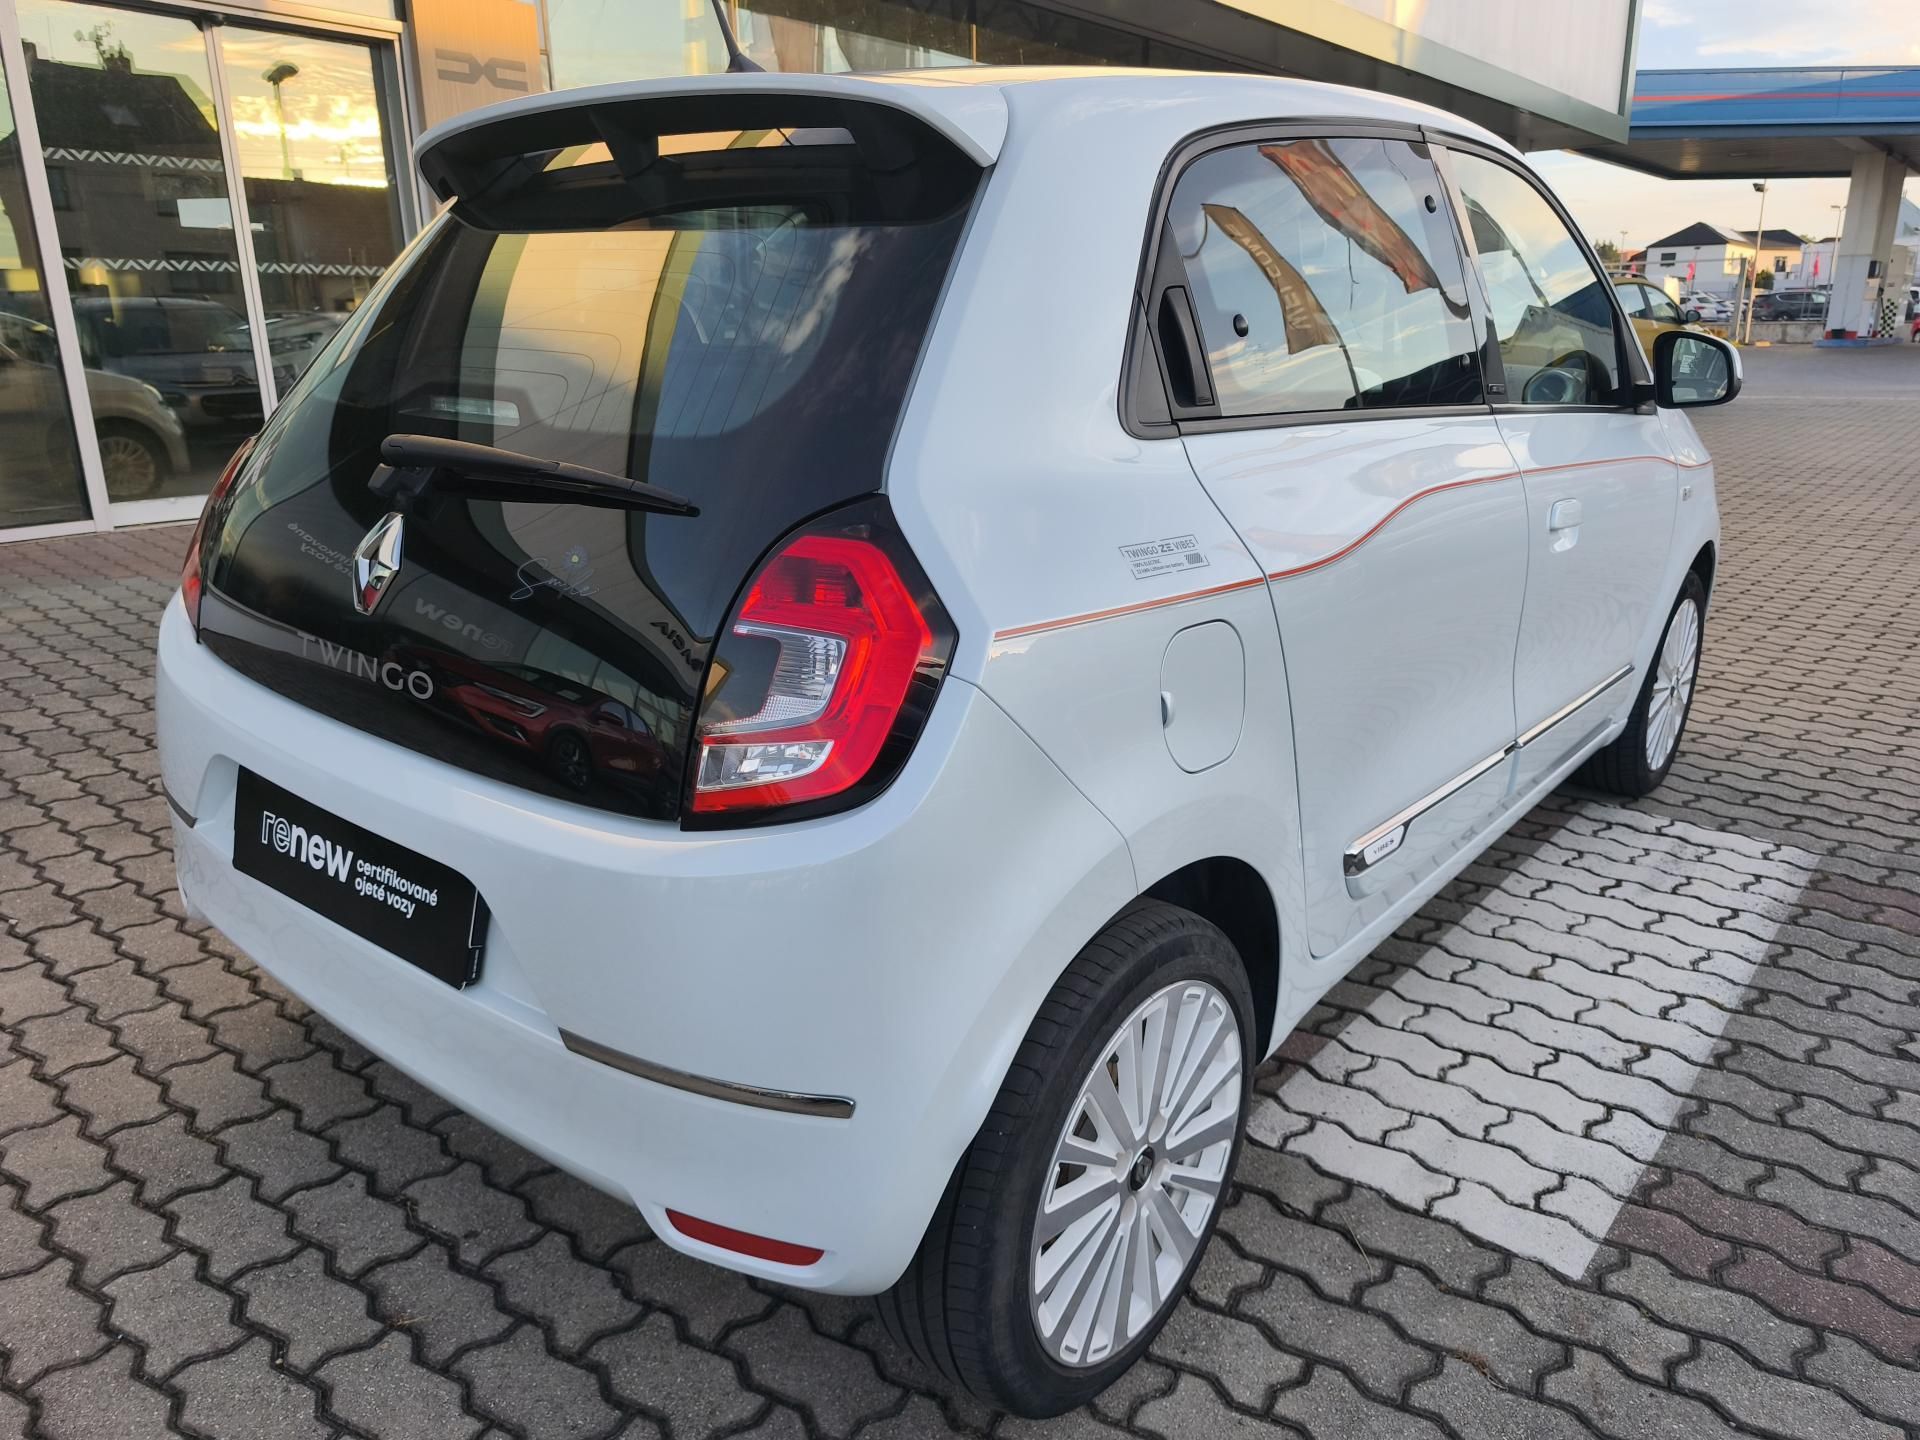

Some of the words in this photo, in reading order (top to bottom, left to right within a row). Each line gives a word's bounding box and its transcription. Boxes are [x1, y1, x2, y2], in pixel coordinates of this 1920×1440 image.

[1125, 546, 1158, 559] TWINGO
[1158, 543, 1174, 553] ZE
[1174, 539, 1195, 551] VIBES
[296, 631, 435, 701] TWINGO
[261, 810, 354, 883] renew
[355, 876, 385, 902] ojeté
[386, 894, 416, 919] vozy
[356, 857, 438, 907] certifikované
